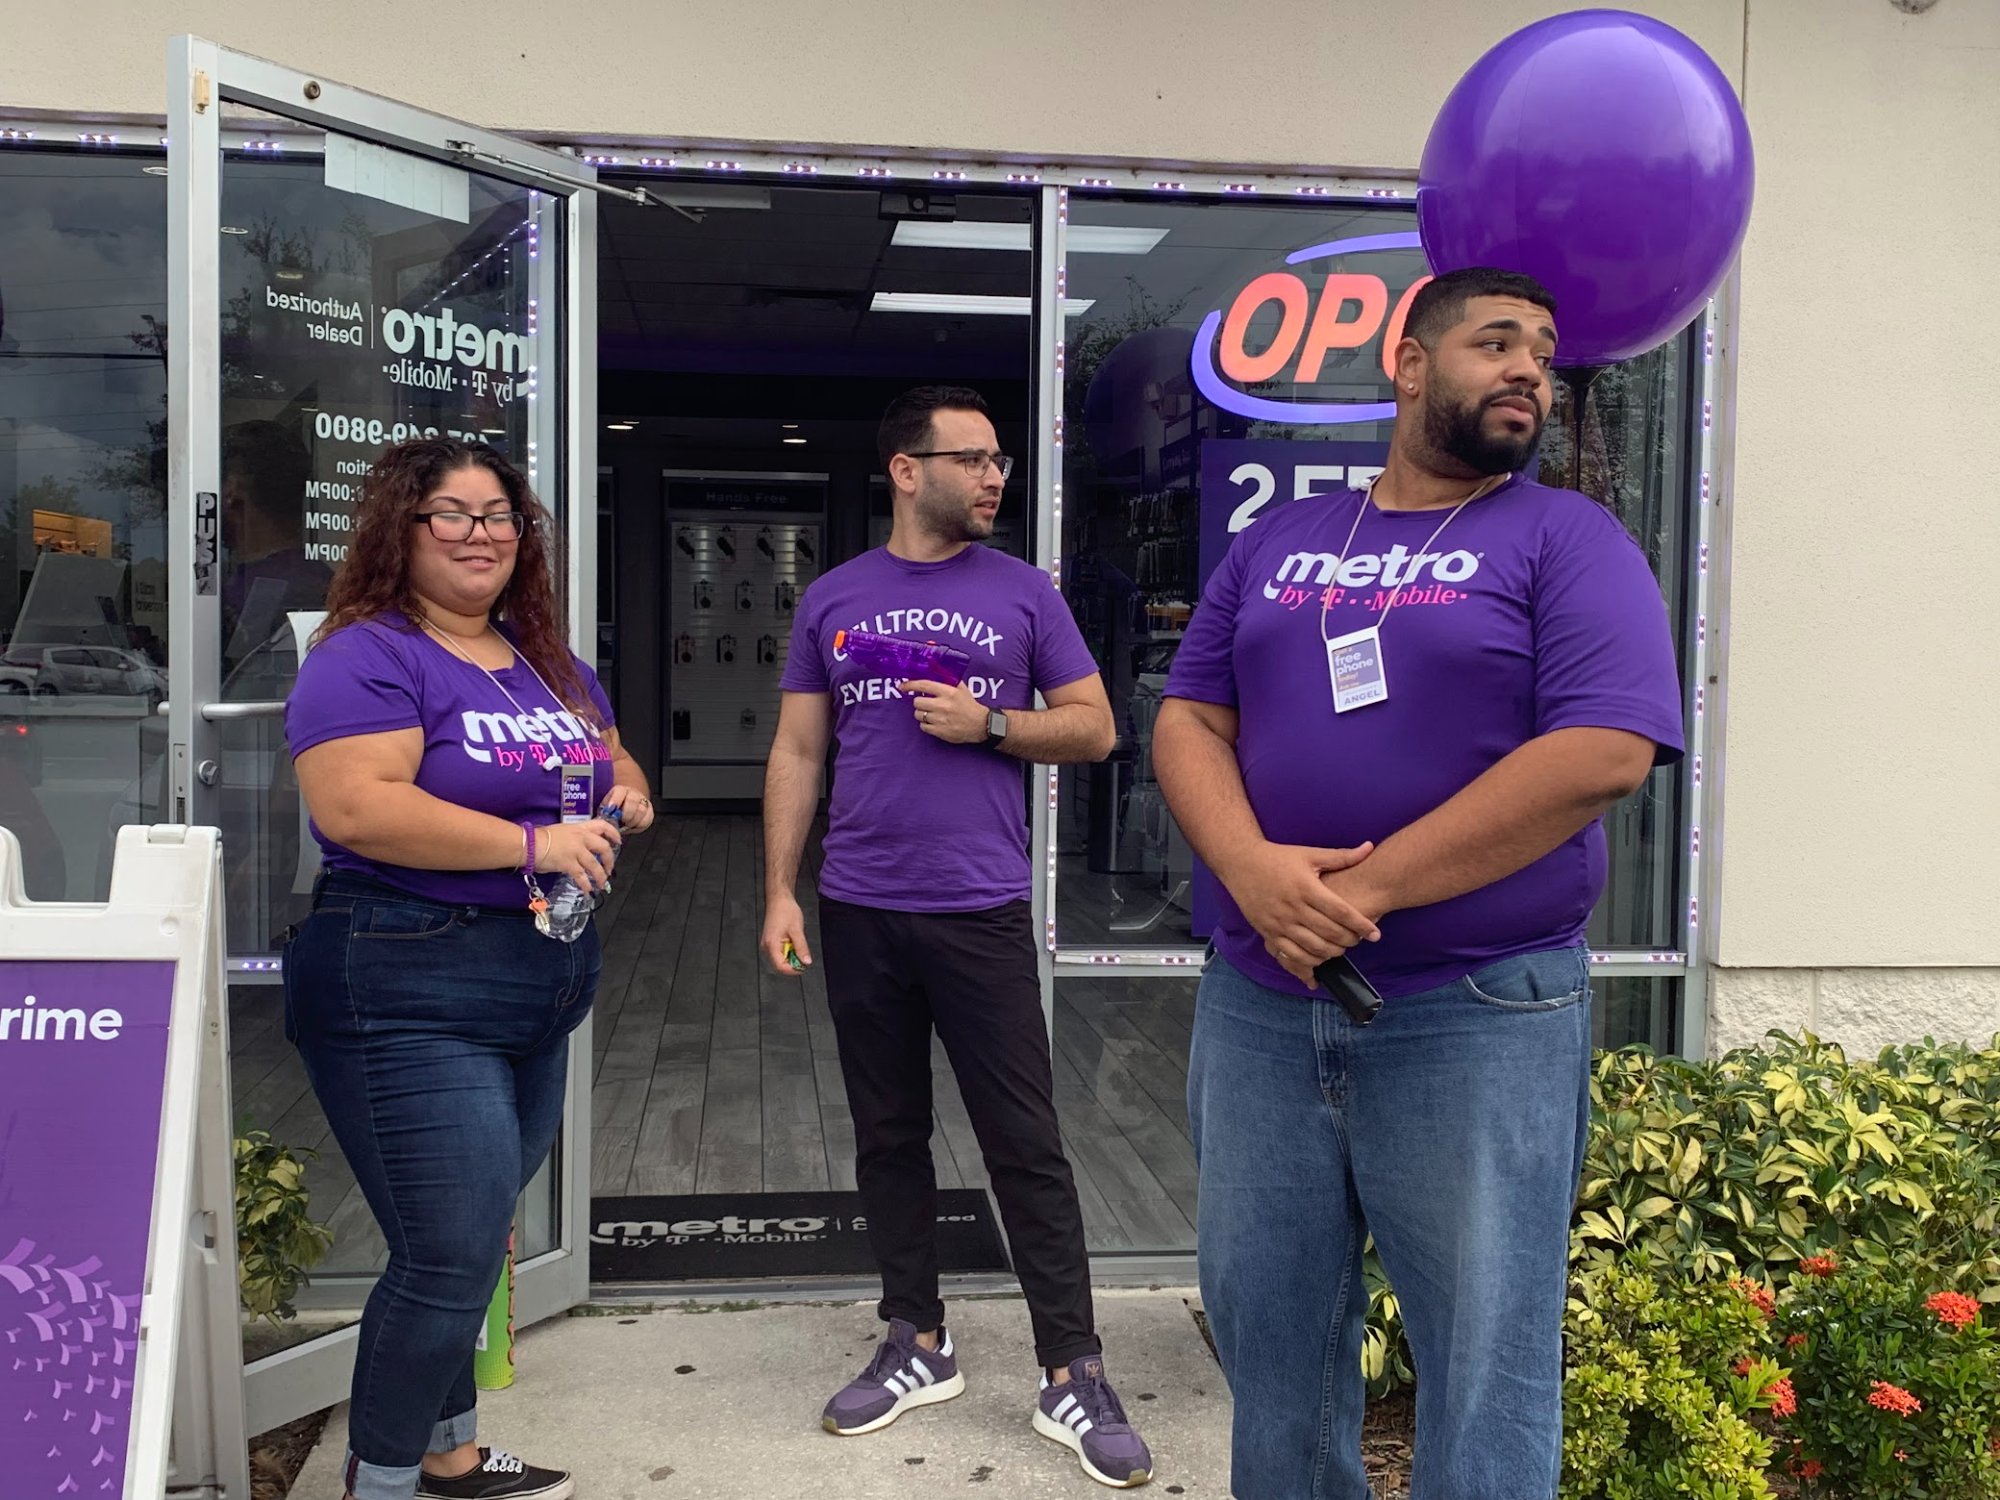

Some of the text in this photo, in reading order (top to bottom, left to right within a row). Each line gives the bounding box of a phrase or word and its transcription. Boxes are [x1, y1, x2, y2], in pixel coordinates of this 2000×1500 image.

[1220, 272, 1433, 383] OP
[1227, 462, 1276, 533] 2
[1264, 544, 1480, 591] metro
[1279, 585, 1314, 611] by
[1335, 651, 1362, 667] free
[1336, 658, 1374, 675] phone
[840, 675, 1005, 706] EVERDY
[494, 746, 526, 772] by
[0, 995, 123, 1041] rime
[595, 1215, 826, 1238] metro
